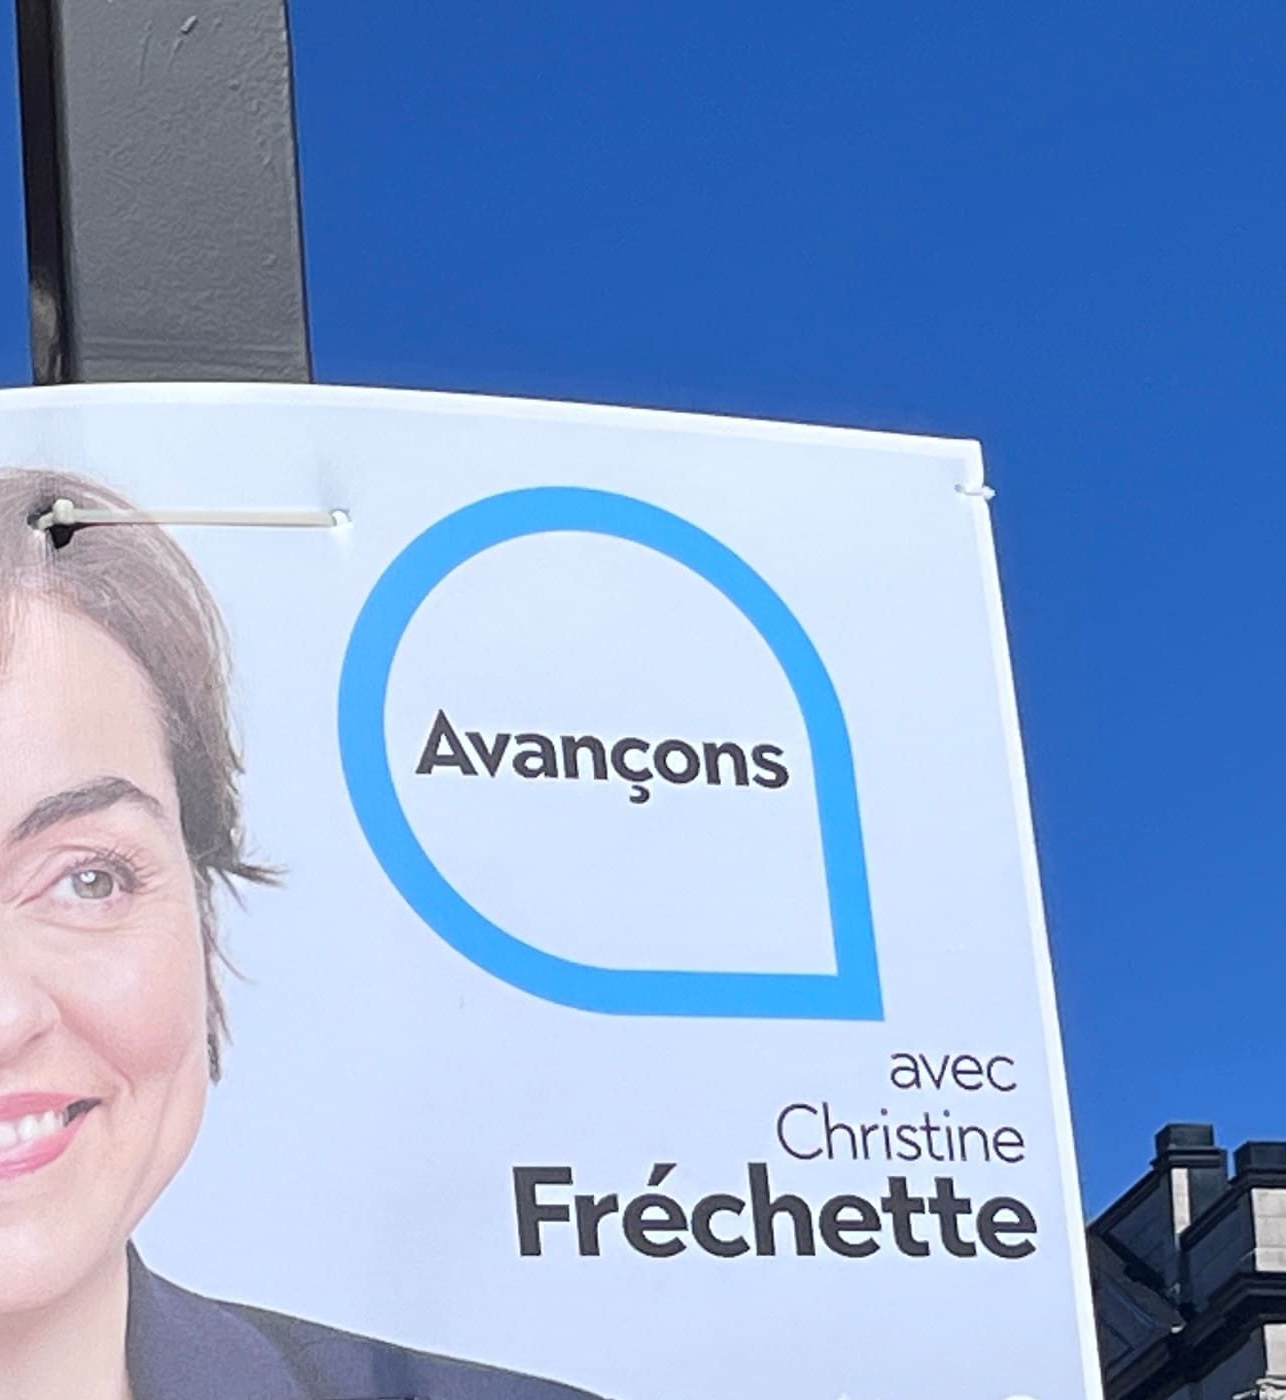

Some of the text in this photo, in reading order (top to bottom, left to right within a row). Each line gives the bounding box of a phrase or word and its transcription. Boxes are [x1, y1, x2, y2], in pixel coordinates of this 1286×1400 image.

[414, 708, 790, 805] Avançons
[889, 1051, 1017, 1092] avec
[777, 1102, 1025, 1163] Christine
[512, 1162, 1037, 1259] Fréchette
